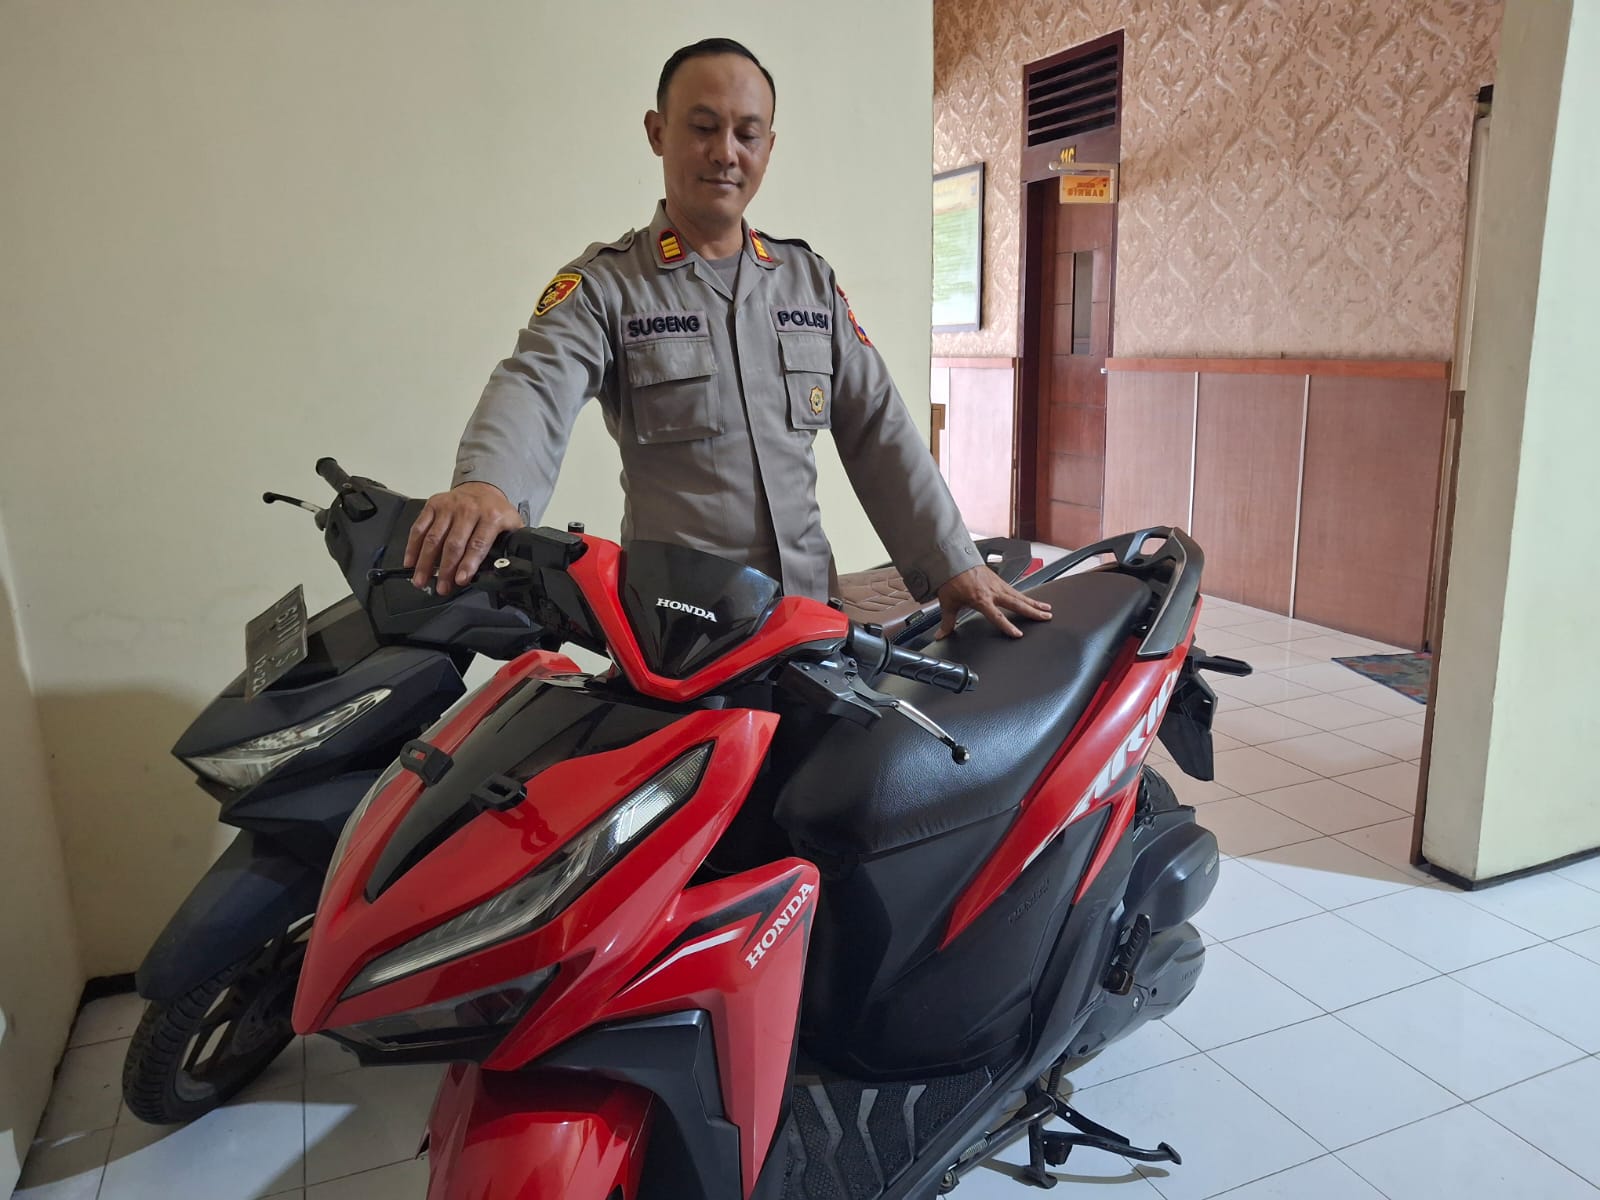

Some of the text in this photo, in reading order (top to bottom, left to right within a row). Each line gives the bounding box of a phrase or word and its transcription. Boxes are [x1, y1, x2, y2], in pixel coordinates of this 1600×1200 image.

[628, 315, 700, 338] SUGENG
[777, 310, 829, 331] POLISI
[656, 597, 718, 623] HONDA
[744, 883, 816, 969] HONDA
